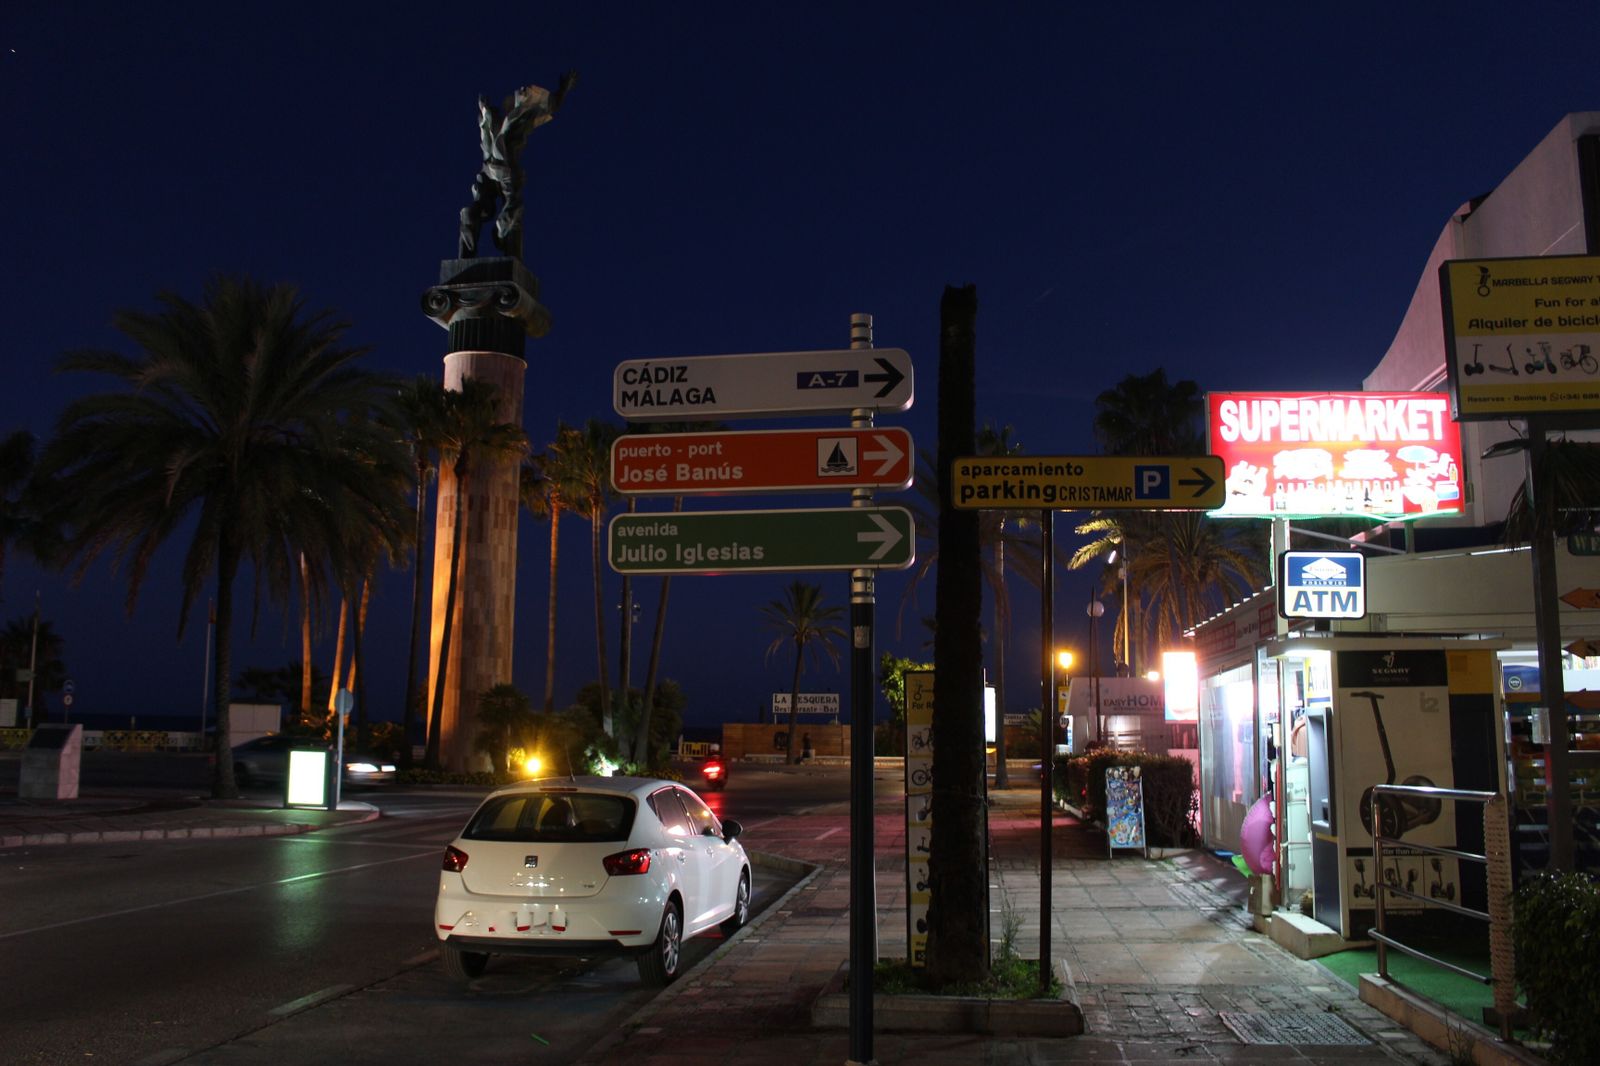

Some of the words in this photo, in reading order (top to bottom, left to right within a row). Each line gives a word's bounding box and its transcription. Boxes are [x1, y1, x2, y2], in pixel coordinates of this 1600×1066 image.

[1492, 277, 1548, 287] MARBELLA
[1551, 275, 1594, 286] SEGWAY
[1534, 298, 1560, 308] Fun
[1565, 297, 1586, 307] for
[1468, 317, 1529, 331] Alquiler
[1534, 316, 1553, 327] de
[1558, 315, 1600, 327] bicicl
[622, 363, 688, 385] CÁDIZ
[808, 373, 848, 387] A-7
[621, 386, 716, 408] MÁLAGA
[1219, 399, 1447, 442] SUPERMARKET
[619, 443, 671, 460] puerto
[688, 441, 722, 459] port
[619, 464, 668, 483] José
[676, 462, 743, 482] Banús
[960, 462, 1084, 479] aparcamiento
[960, 480, 1057, 503] parking
[1060, 486, 1133, 502] CRISTAMAR
[1143, 470, 1162, 494] P
[617, 522, 679, 538] avenida
[616, 544, 667, 563] Julio
[676, 542, 764, 564] Iglesias
[1292, 590, 1358, 612] ATM
[774, 694, 788, 704] LA
[797, 695, 838, 705] ESQUERA
[1103, 694, 1161, 707] EASYHOM
